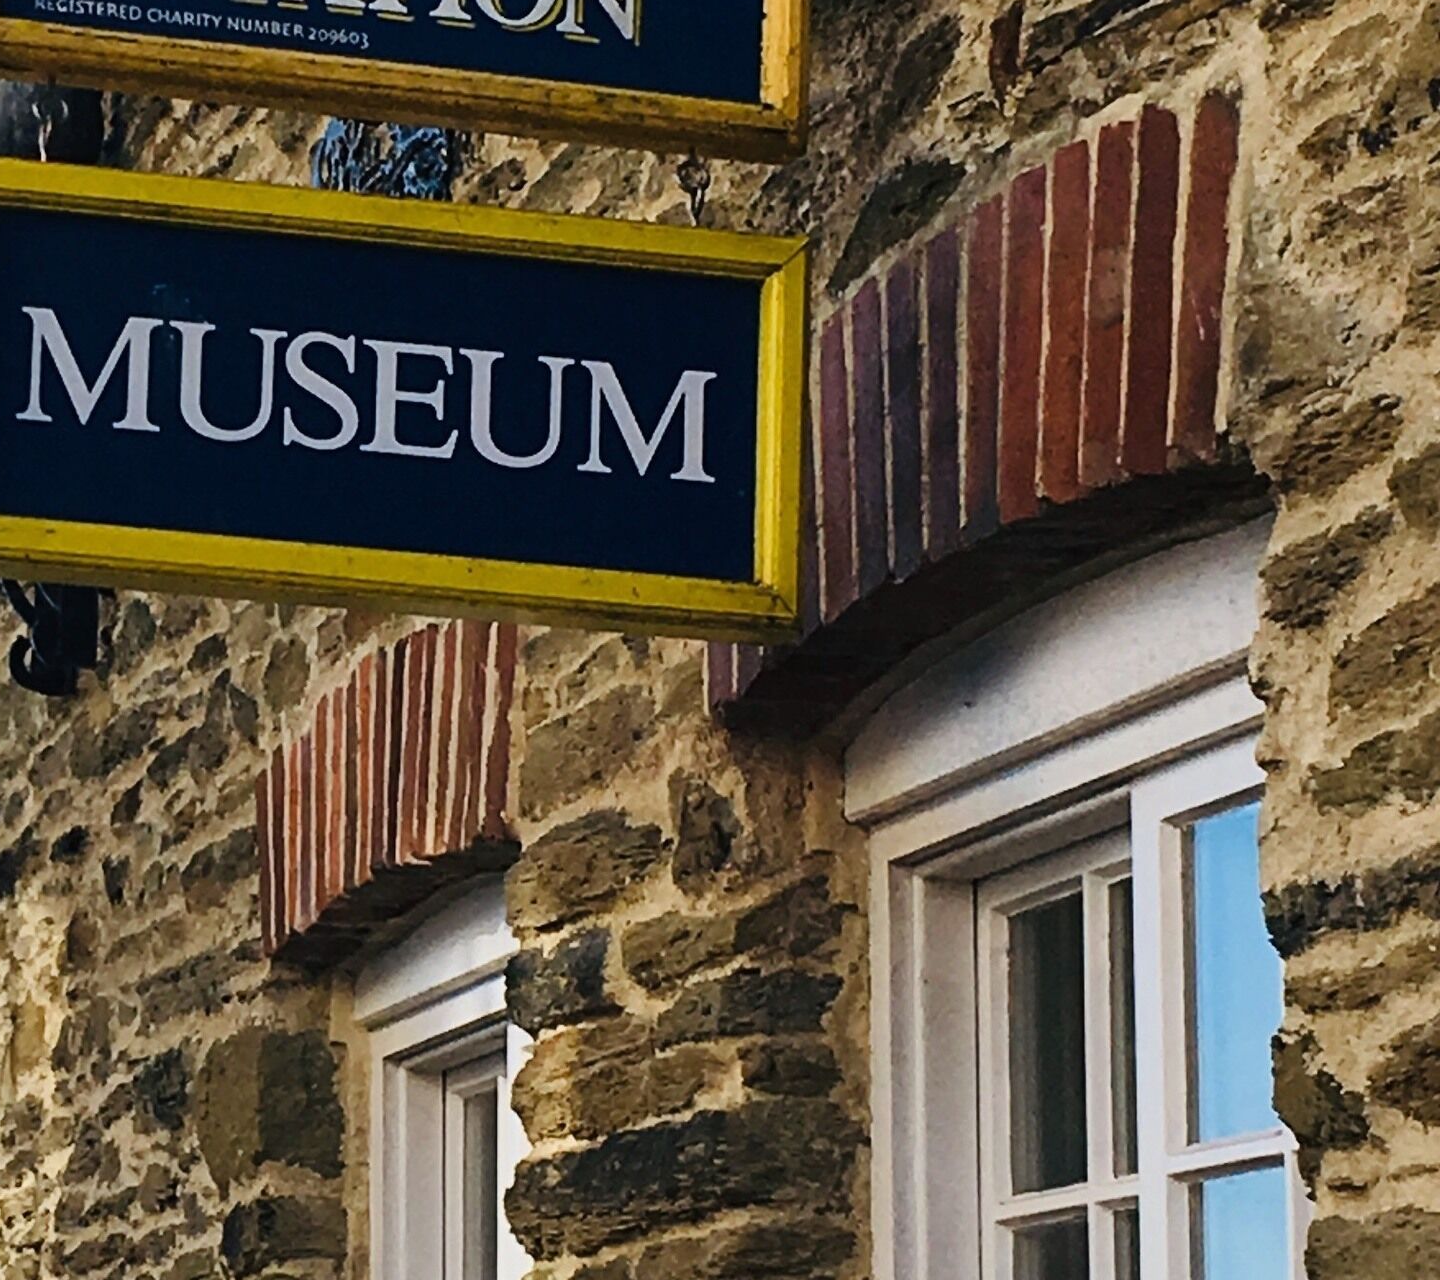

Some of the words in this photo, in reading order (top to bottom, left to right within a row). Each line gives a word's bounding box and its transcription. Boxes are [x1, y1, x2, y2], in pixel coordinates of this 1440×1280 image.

[147, 8, 222, 29] CHARITY
[227, 17, 304, 38] NUMBER
[308, 27, 369, 49] 209603
[16, 307, 717, 482] MUSEUM
